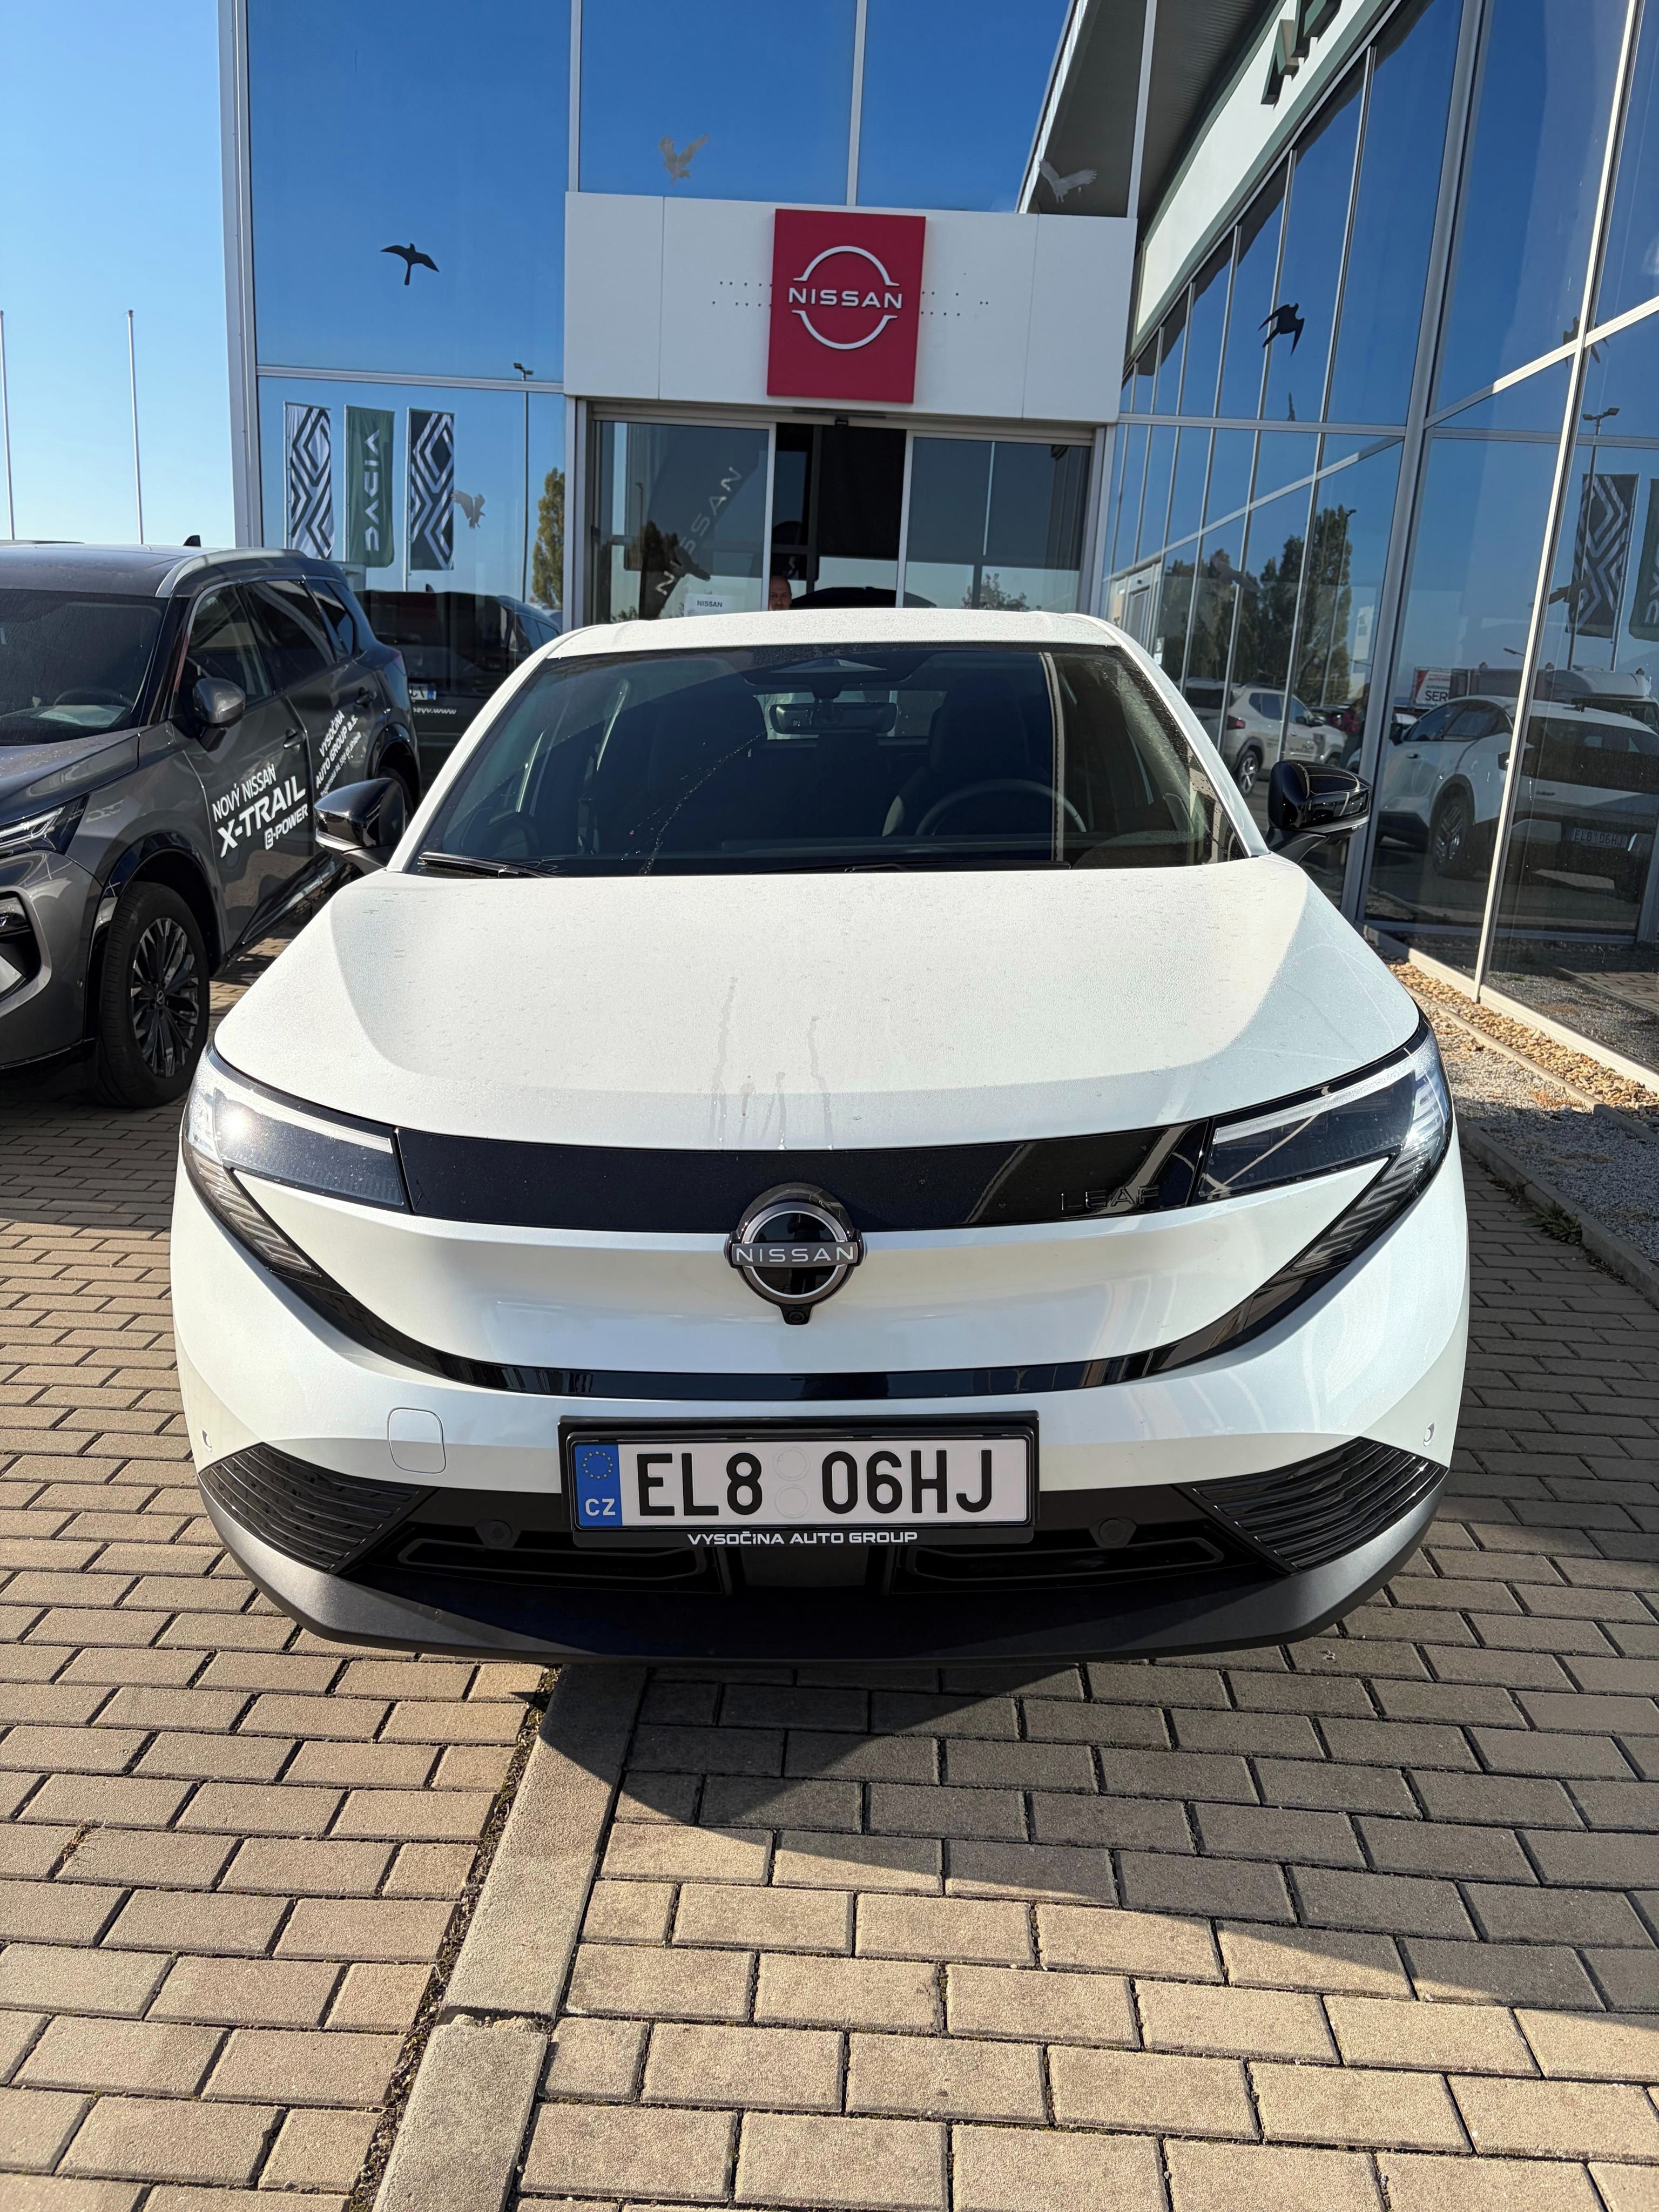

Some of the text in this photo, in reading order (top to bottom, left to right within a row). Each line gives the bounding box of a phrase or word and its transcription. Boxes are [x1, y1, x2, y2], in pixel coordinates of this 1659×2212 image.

[788, 288, 902, 309] NISSAN
[365, 429, 380, 551] DACIA
[315, 757, 331, 789] AUTO
[329, 725, 348, 762] GROUP
[347, 714, 359, 731] a.s.
[212, 783, 240, 822] NOVÝ
[241, 764, 276, 802] NISSAN
[217, 775, 306, 858] X-TRAIL
[1061, 1184, 1159, 1211] LEAF
[736, 1246, 853, 1262] NISSAN
[636, 1449, 993, 1516] EL8 06HJ
[585, 1498, 616, 1517] CZ
[790, 1533, 844, 1544] AUTO
[849, 1532, 918, 1543] GROUP
